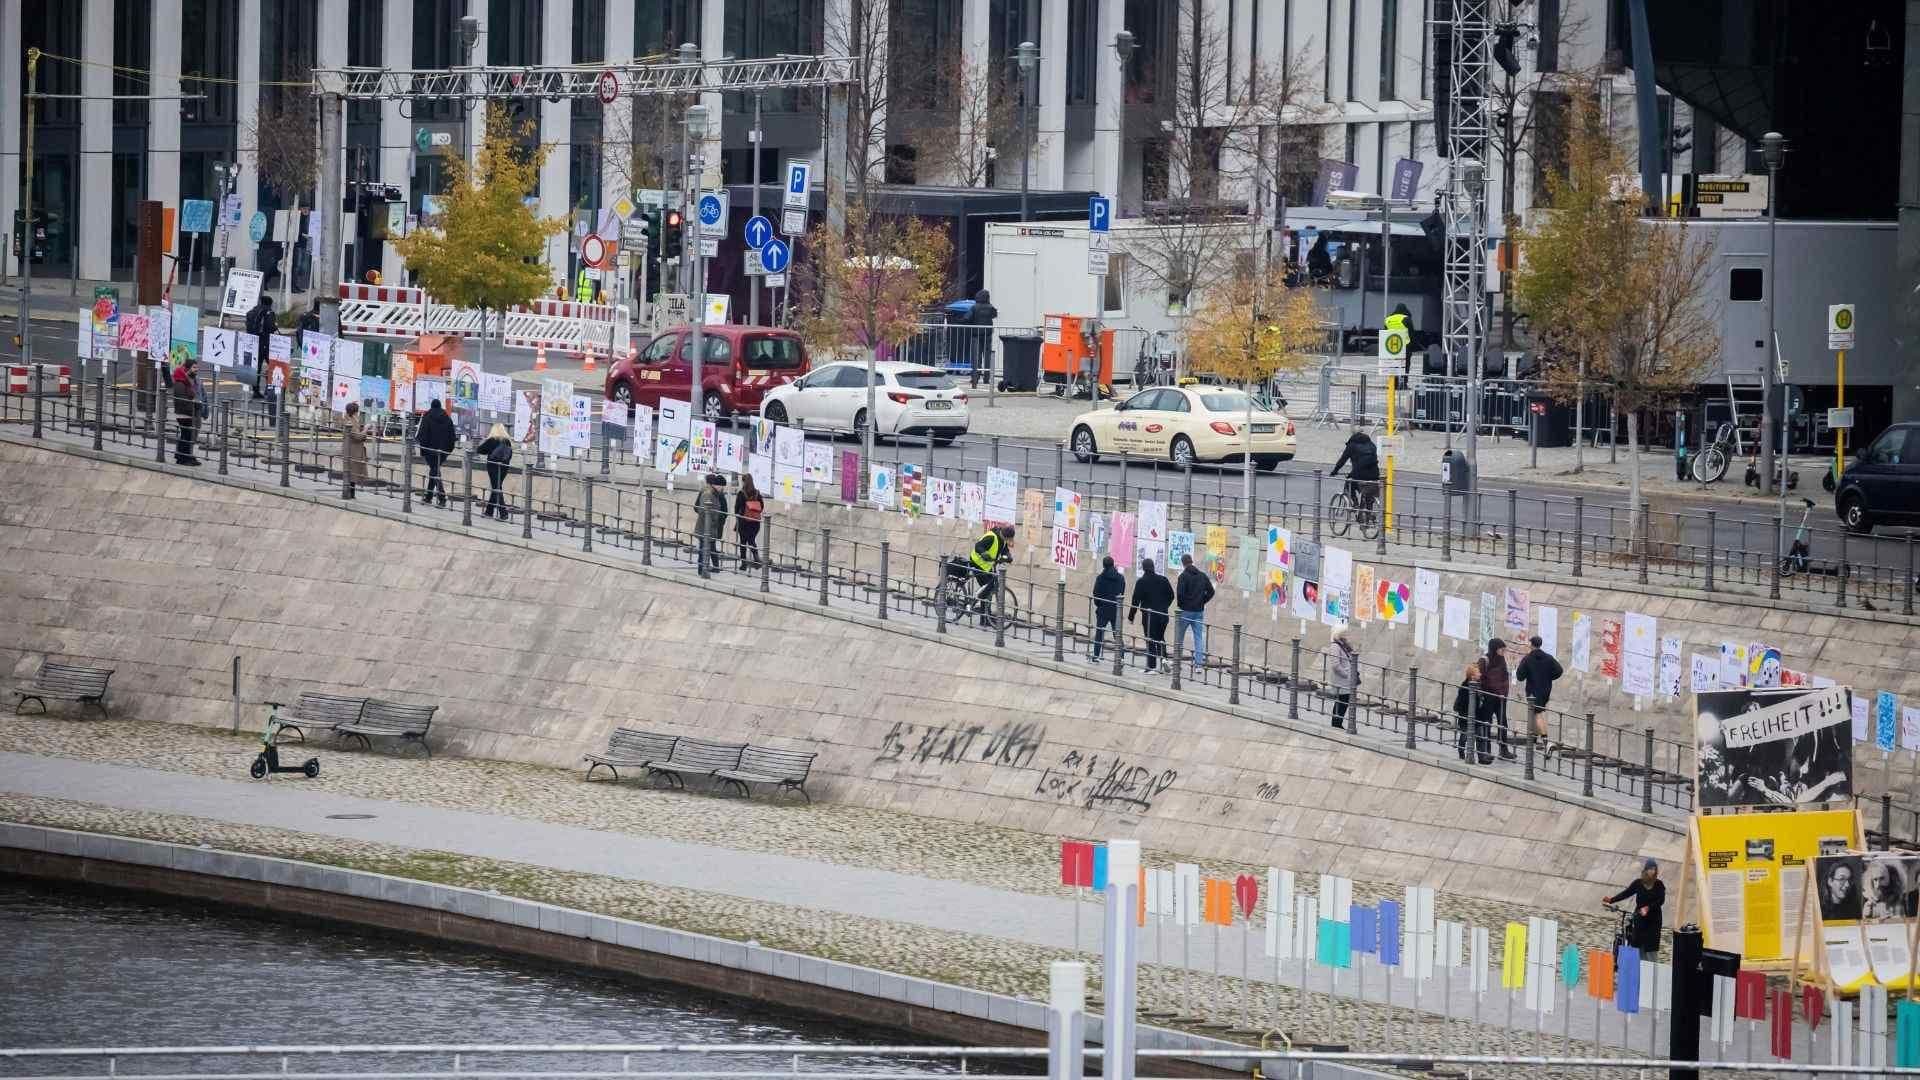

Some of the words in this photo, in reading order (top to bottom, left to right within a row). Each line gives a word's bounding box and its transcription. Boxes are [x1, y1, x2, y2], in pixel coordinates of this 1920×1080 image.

[794, 170, 802, 190] P
[1094, 202, 1105, 227] P
[1057, 527, 1080, 549] LAUT
[1054, 545, 1077, 568] SEIN
